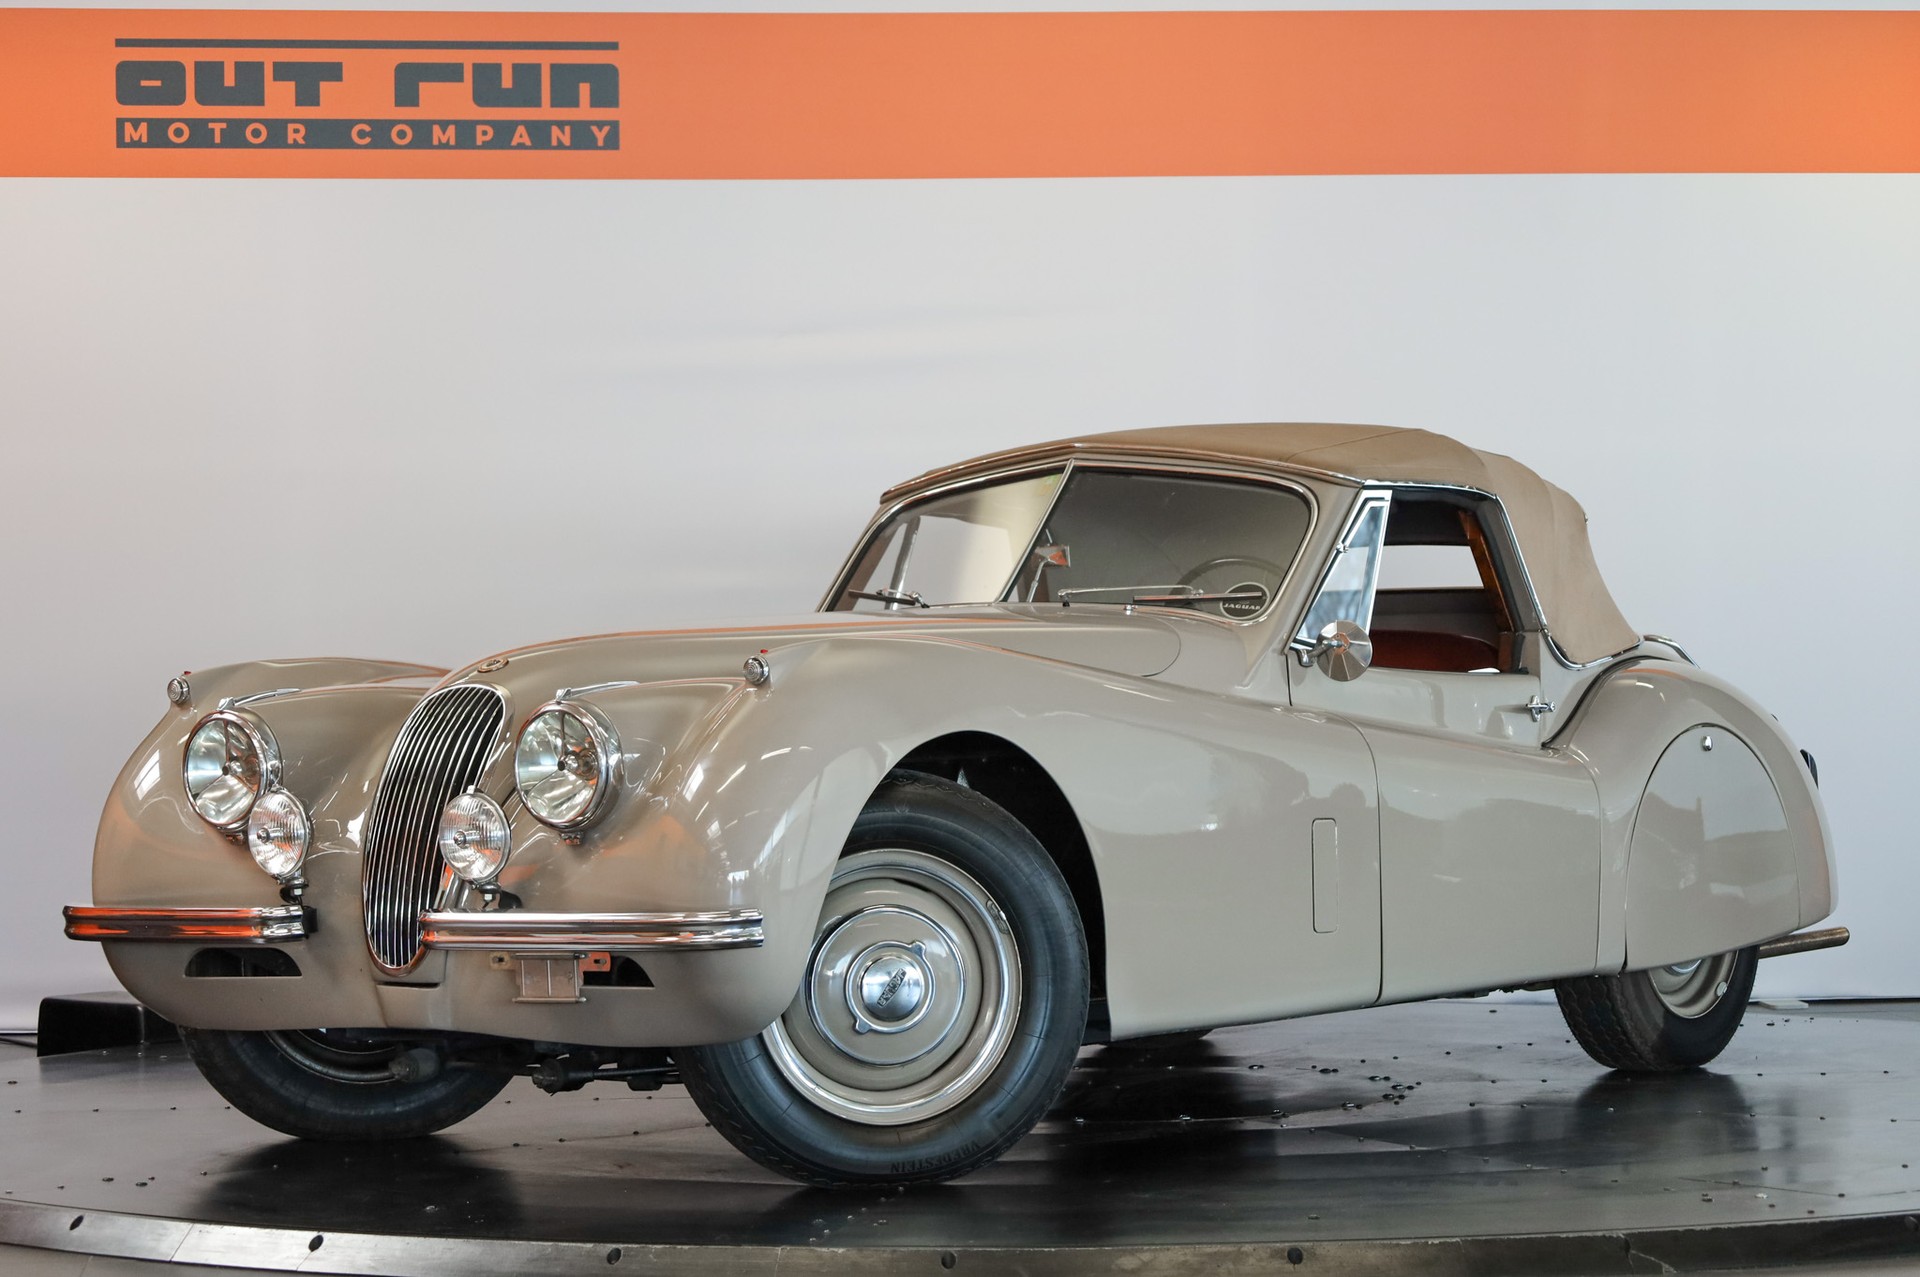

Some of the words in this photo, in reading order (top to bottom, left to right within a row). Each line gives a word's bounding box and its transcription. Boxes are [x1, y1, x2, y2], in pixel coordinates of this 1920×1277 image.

[124, 121, 306, 145] MOTOR
[351, 123, 612, 147] COMPANY
[1223, 602, 1261, 610] JAGUAR
[877, 968, 907, 1008] JAGUAR
[890, 1139, 982, 1174] VREDESTEIN
